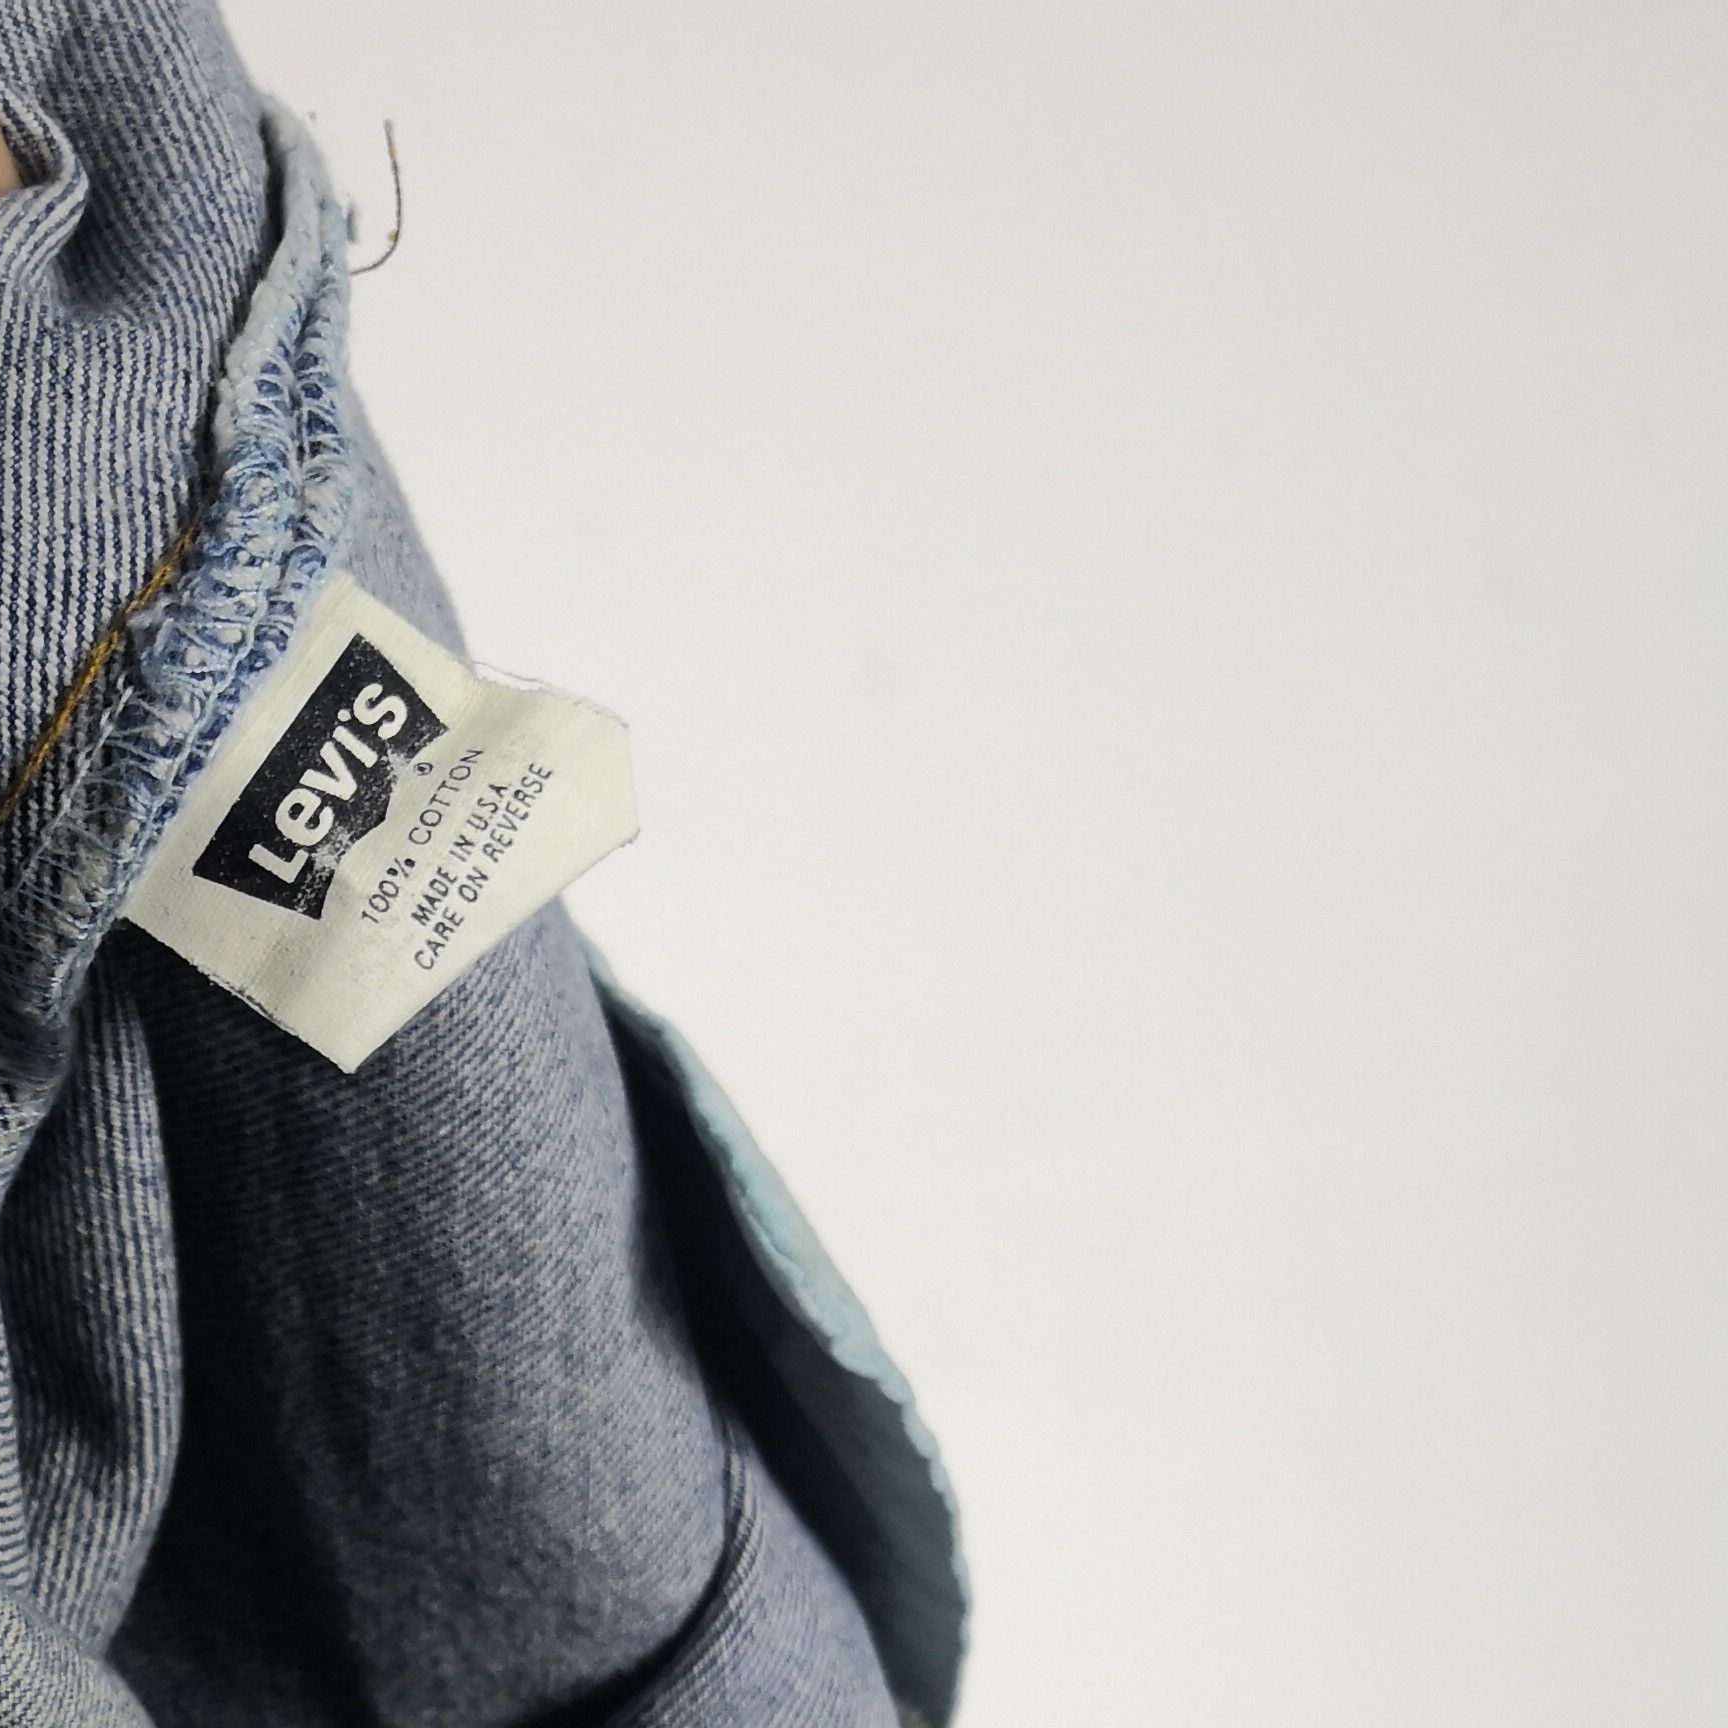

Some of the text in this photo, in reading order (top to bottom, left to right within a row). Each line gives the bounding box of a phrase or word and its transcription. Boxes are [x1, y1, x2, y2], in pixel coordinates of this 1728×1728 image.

[358, 750, 485, 924] 100% COTTON
[408, 865, 459, 928] MADE
[449, 832, 477, 863] IN
[413, 762, 553, 969] CARE ON REVERSE
